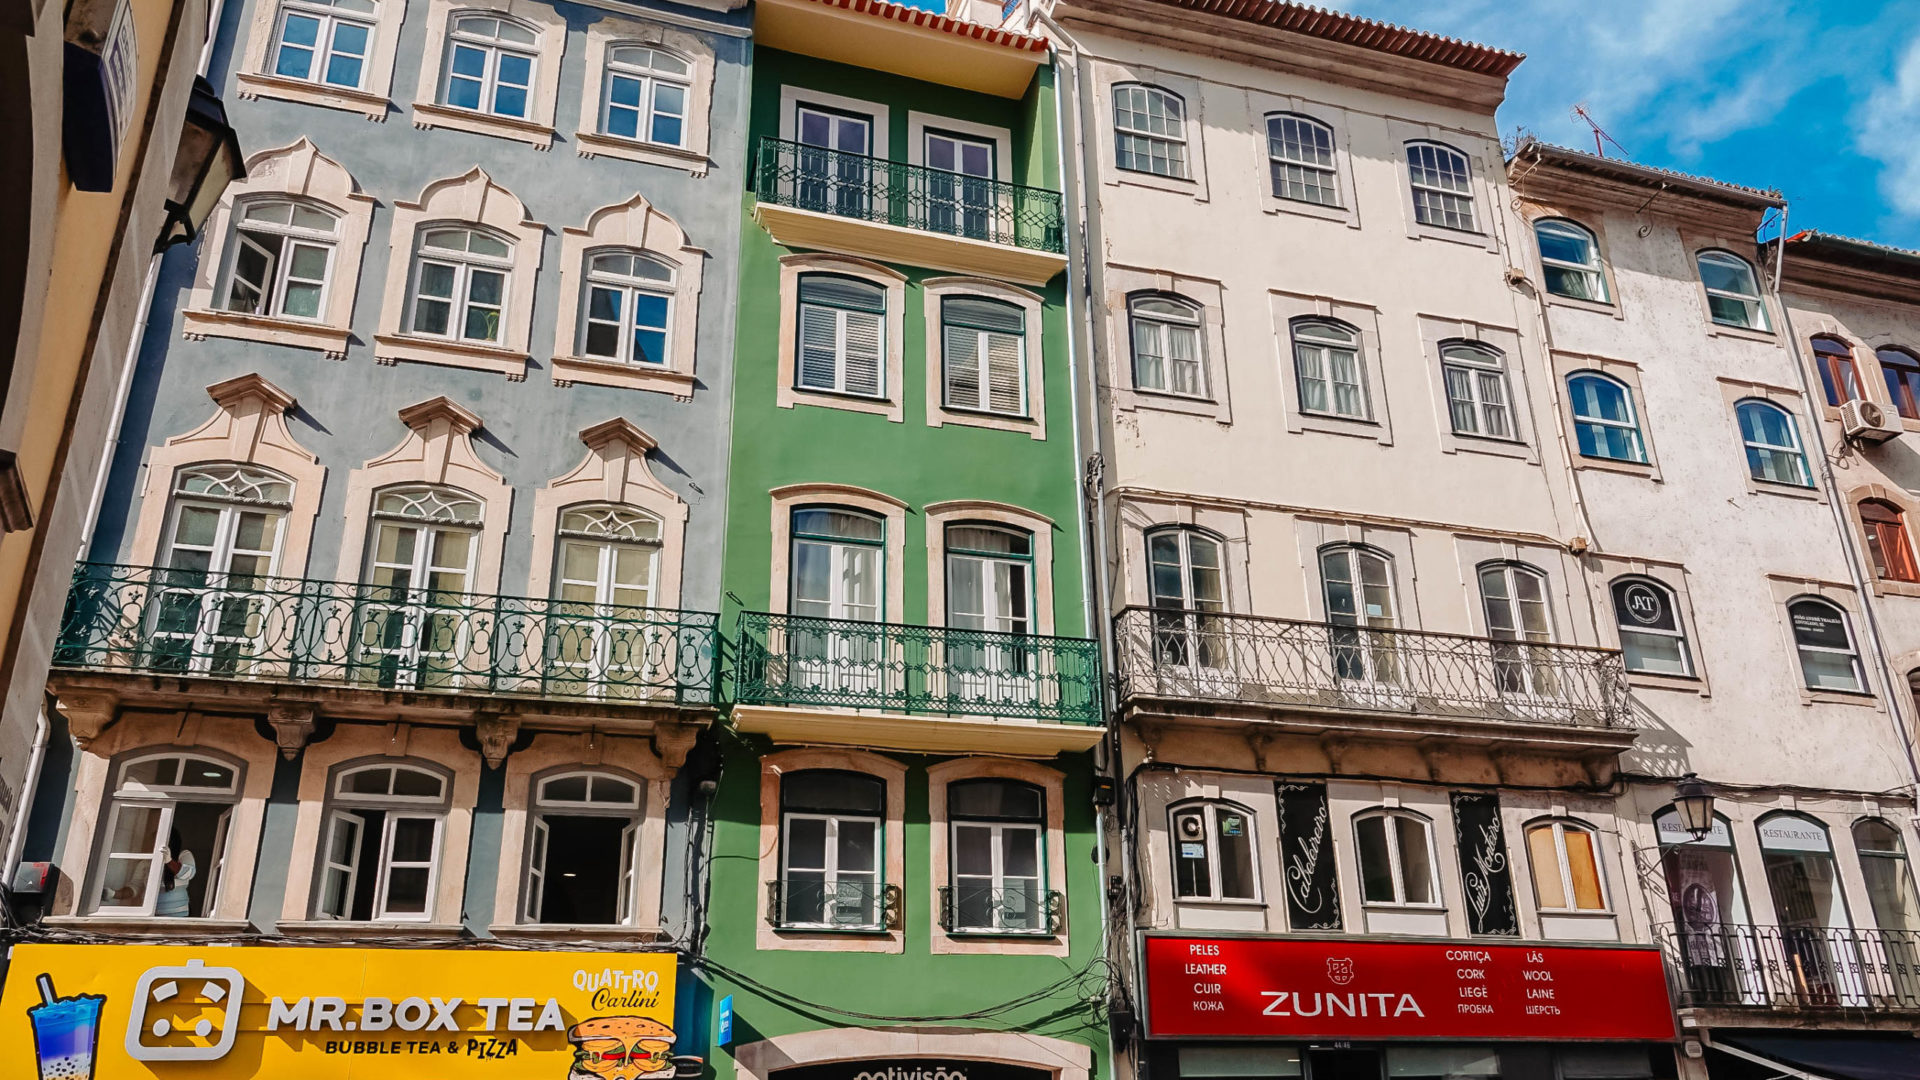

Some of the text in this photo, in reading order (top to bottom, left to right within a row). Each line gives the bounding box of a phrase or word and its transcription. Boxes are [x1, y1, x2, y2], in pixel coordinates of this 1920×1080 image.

[1632, 595, 1654, 611] AT
[1763, 829, 1823, 840] RESTAURANTE
[1287, 795, 1328, 914] Cabeleireiro
[1189, 944, 1220, 956] PELES
[1445, 950, 1492, 963] CORTIÇA
[1526, 951, 1544, 963] LÃS
[1185, 963, 1227, 975] LEATHER
[1456, 968, 1486, 979] CORK
[572, 968, 659, 994] QUATTRO
[1522, 970, 1554, 981] WOOL
[1193, 983, 1222, 994] CUIR
[1526, 988, 1555, 999] LAINE
[591, 987, 660, 1011] Carlini
[1261, 991, 1425, 1017] ZUNITA
[1193, 1001, 1225, 1011] КОЖА
[1457, 1003, 1494, 1014] ПРОБКА
[1525, 1005, 1561, 1015] ШЕРСТЬ
[267, 997, 565, 1031] MR.BOX TEA
[325, 1038, 518, 1060] BUBBLE TEA & PIZZA
